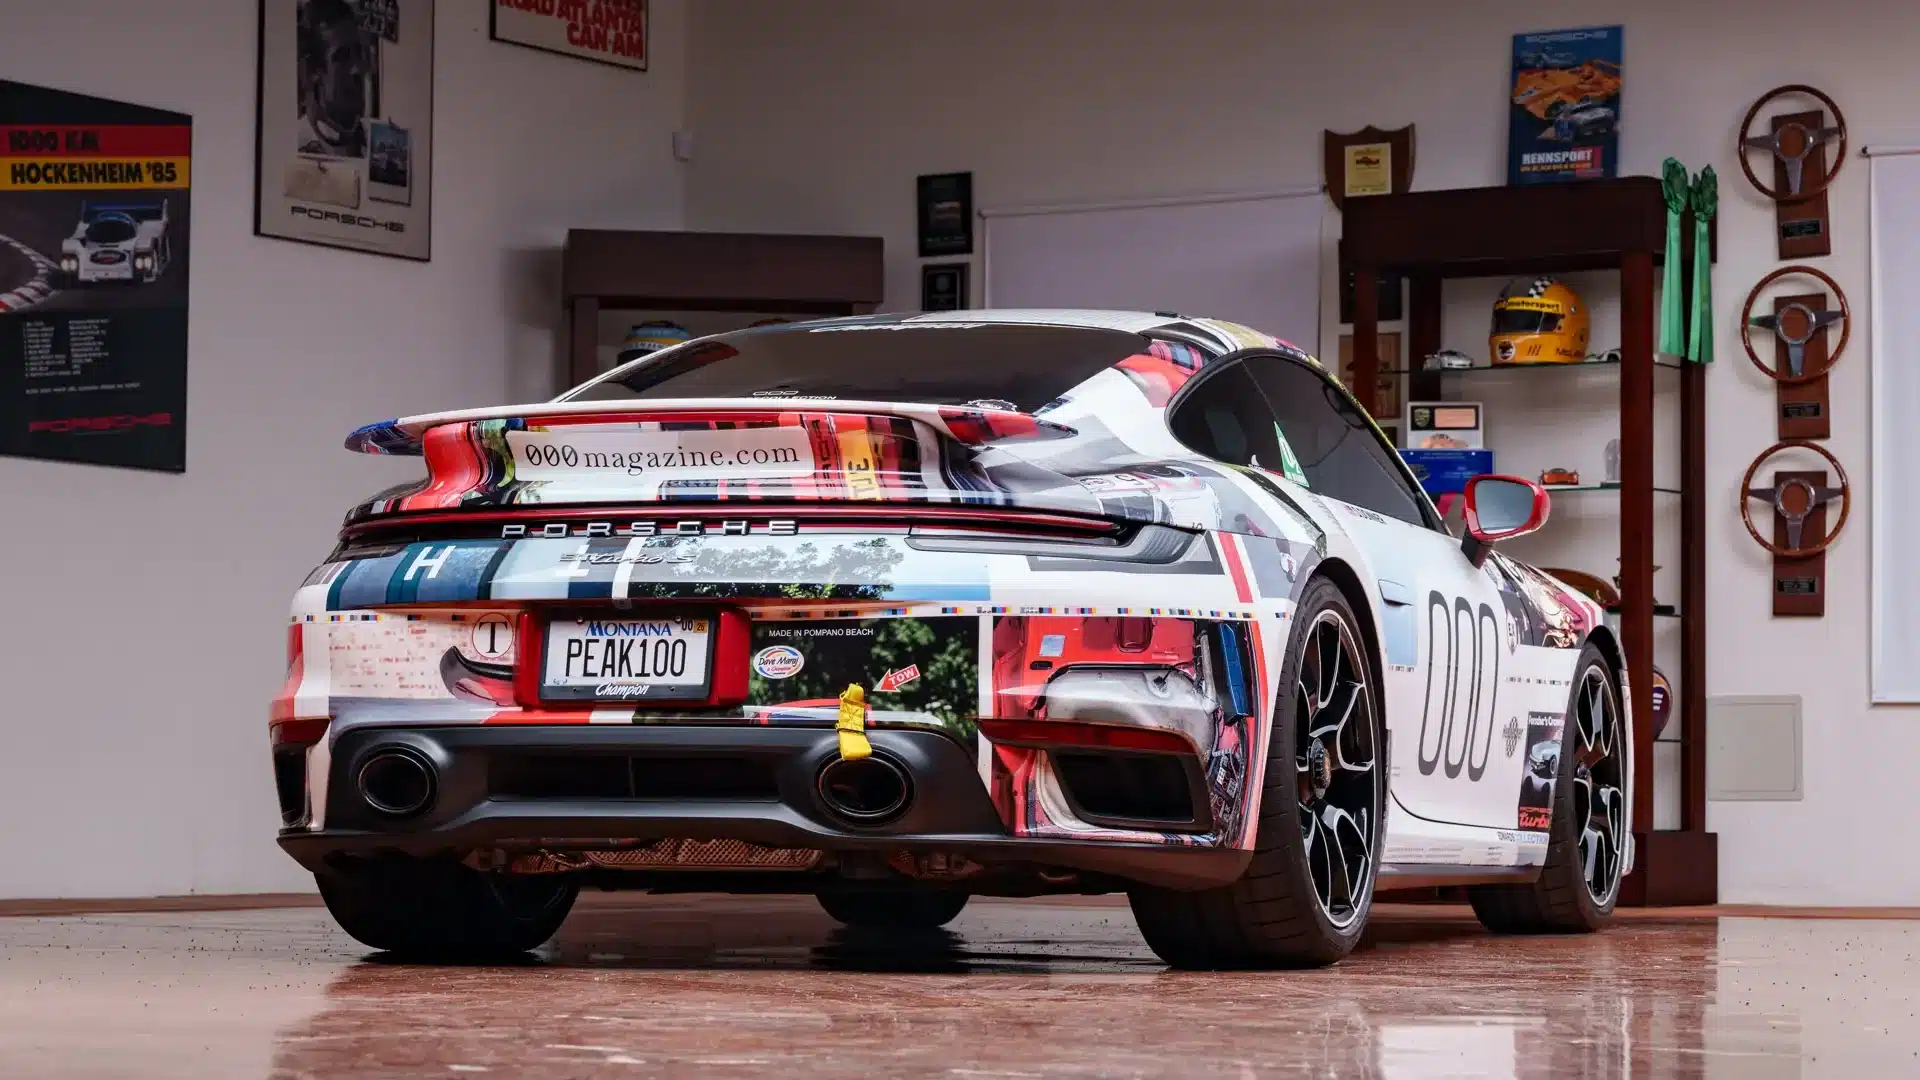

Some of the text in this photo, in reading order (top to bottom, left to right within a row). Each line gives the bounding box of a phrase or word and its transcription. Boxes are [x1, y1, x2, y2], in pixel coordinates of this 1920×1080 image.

[497, 0, 554, 16] OAD
[8, 130, 58, 151] 1000
[1522, 150, 1593, 165] RENNSPORT
[10, 162, 177, 184] HOCKENHEIM '85
[291, 205, 405, 233] PORSCHE
[501, 520, 799, 538] PORSCHE
[585, 620, 673, 637] MONTANA
[769, 628, 874, 637] MADE IN POMPANO BEACH
[478, 621, 508, 654] T
[565, 638, 687, 678] PEAK100
[758, 657, 776, 666] Dave
[889, 669, 915, 686] TOW
[595, 683, 650, 699] Champion
